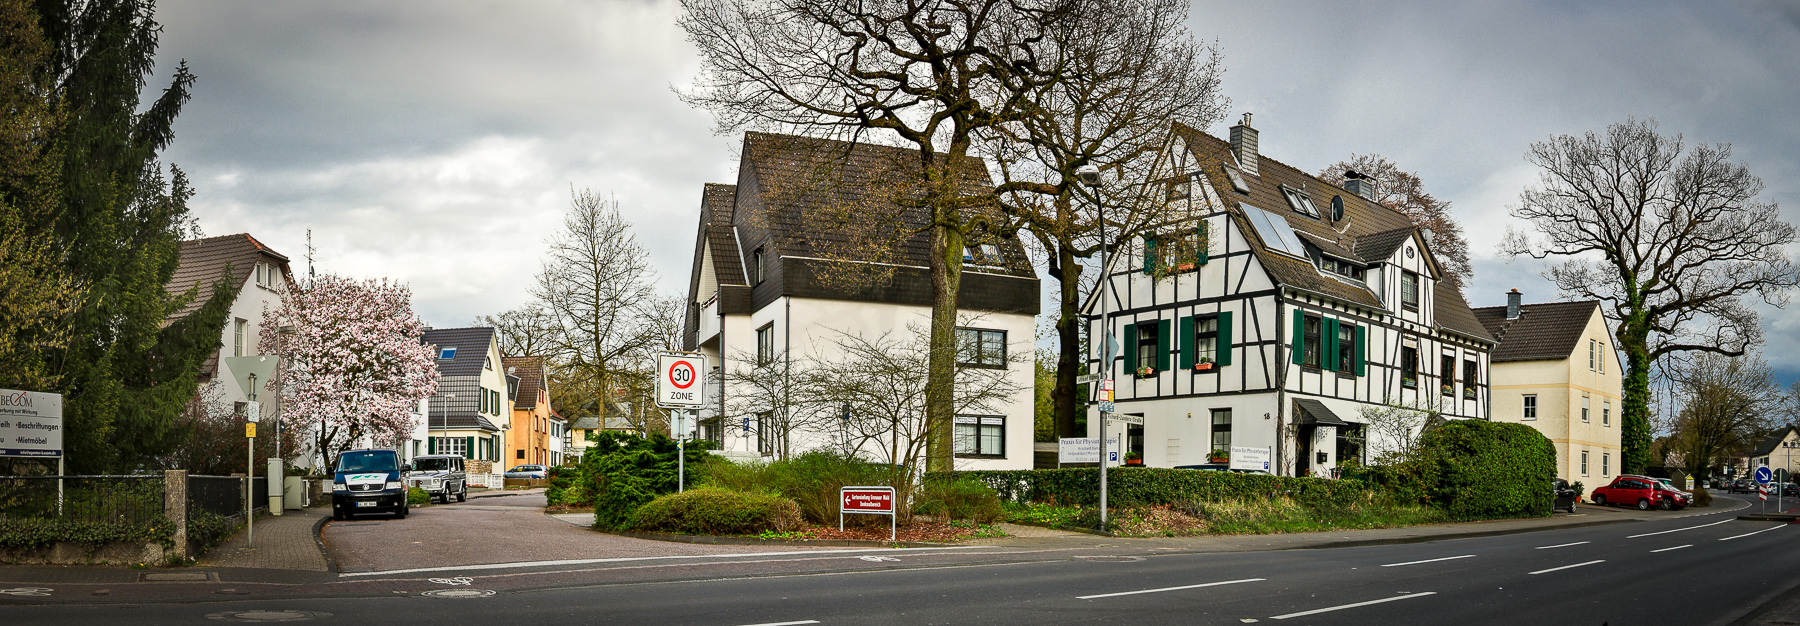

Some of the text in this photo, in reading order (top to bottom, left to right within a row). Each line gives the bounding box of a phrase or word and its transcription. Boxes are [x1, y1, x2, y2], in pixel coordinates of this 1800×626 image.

[674, 368, 690, 382] 30
[670, 391, 694, 401] ZONE
[18, 422, 58, 431] Beschriftungen
